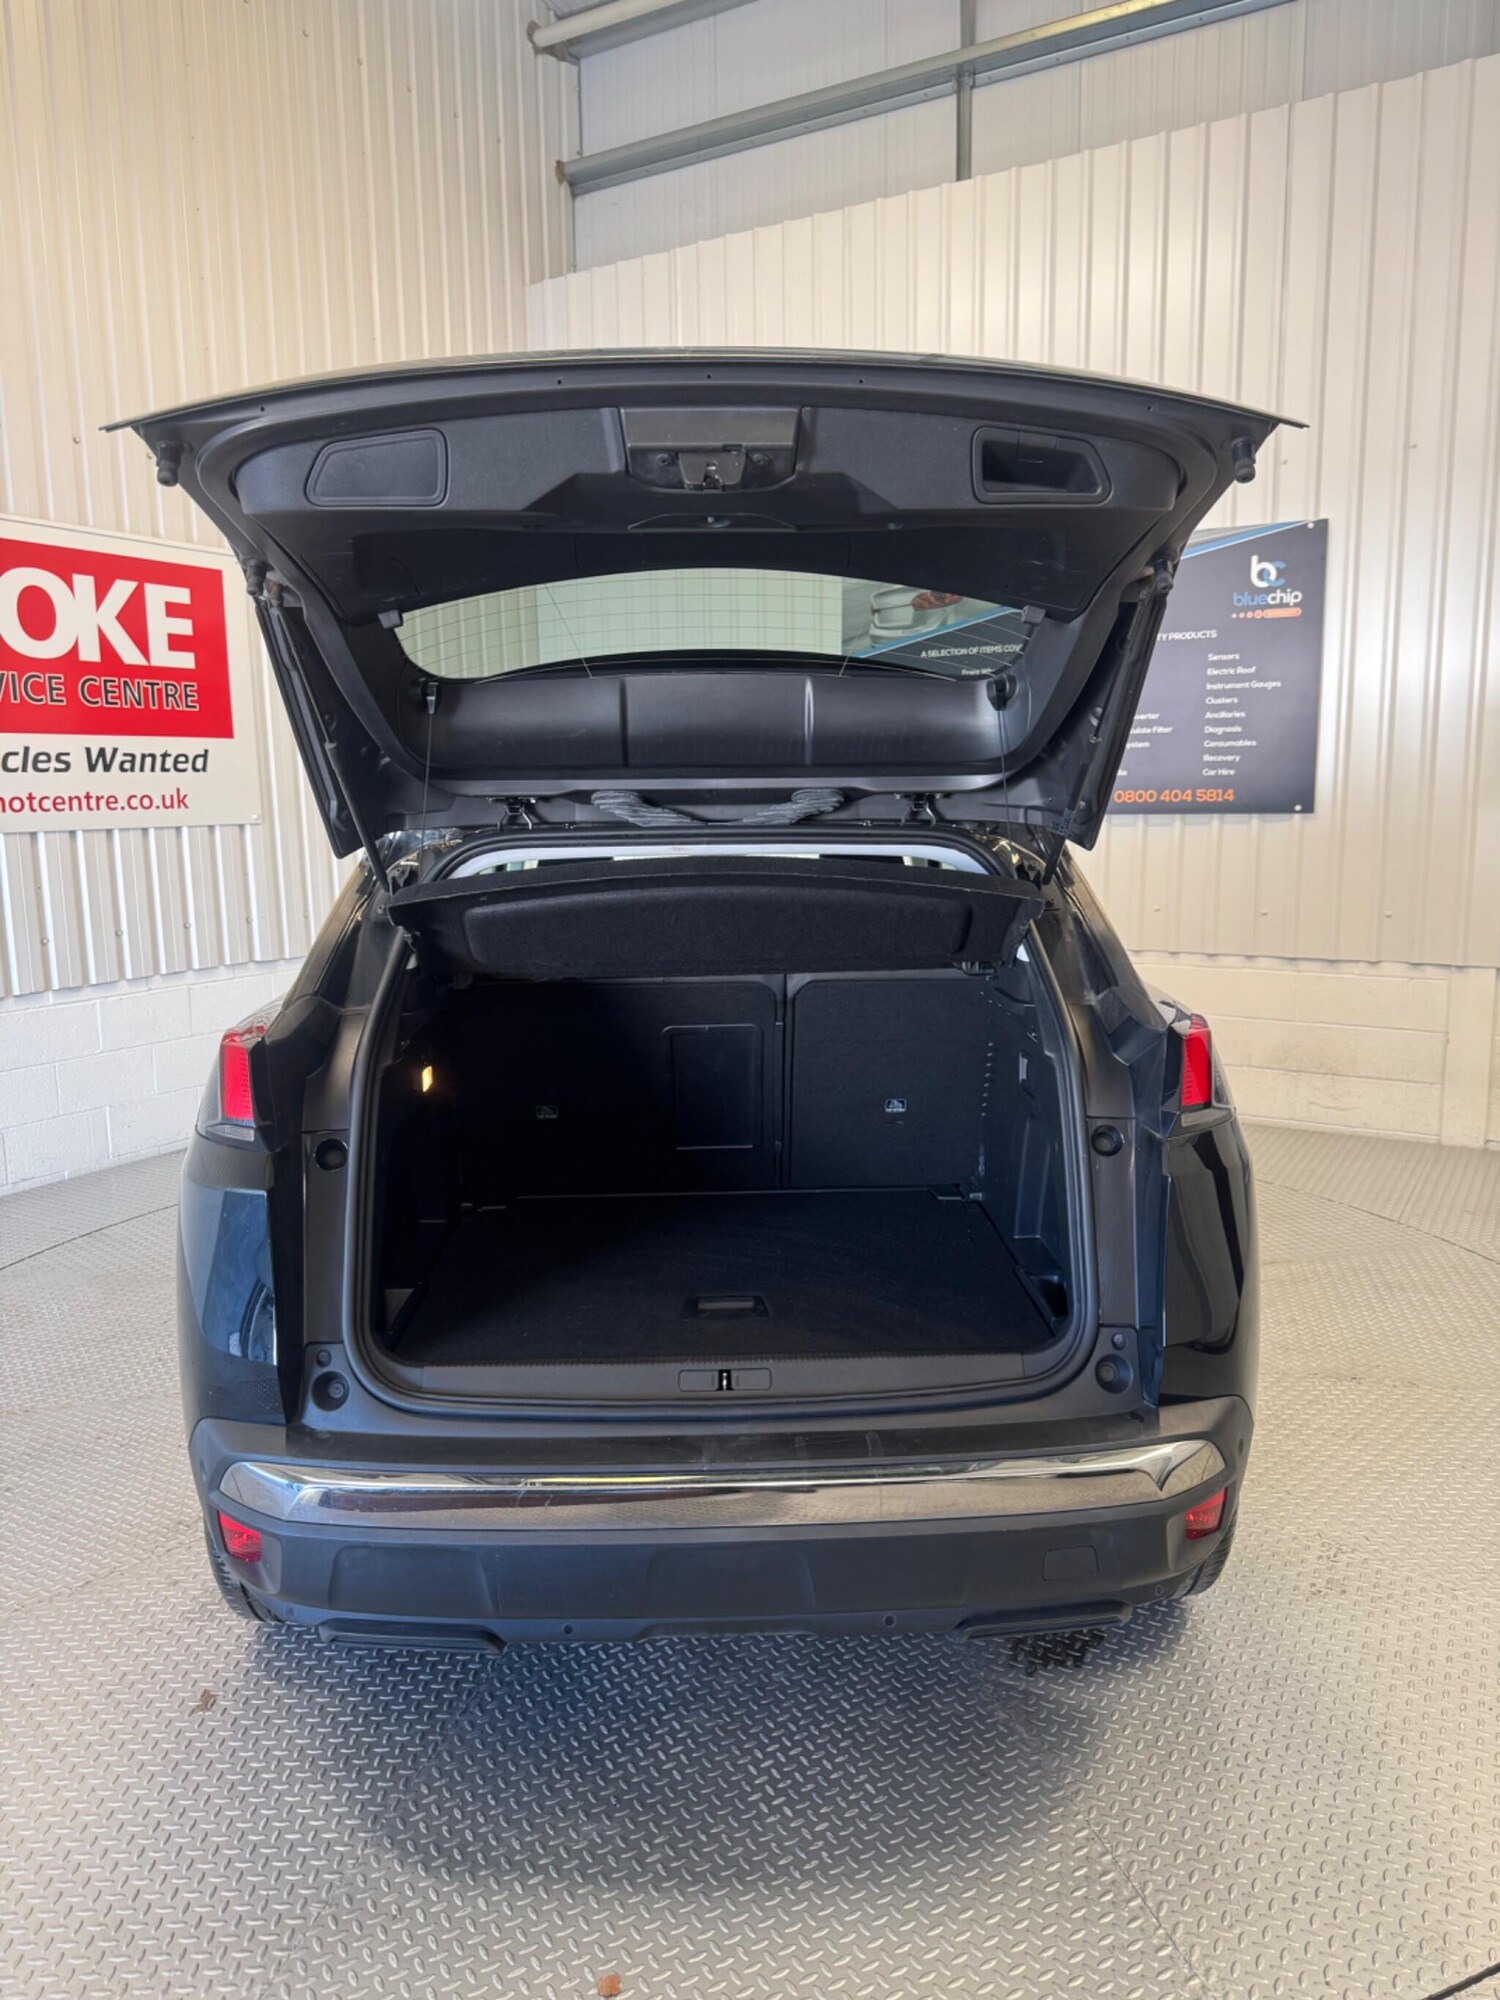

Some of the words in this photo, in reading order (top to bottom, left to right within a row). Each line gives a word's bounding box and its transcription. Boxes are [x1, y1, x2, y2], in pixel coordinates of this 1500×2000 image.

[1233, 588, 1302, 607] bluechip
[0, 566, 196, 669] OKE
[1169, 629, 1217, 641] PRODUCTS
[928, 647, 967, 657] SELECTION
[1207, 653, 1240, 661] Sensors
[1206, 667, 1235, 676] Electric
[1236, 665, 1257, 674] Roof
[1206, 682, 1249, 691] Instrument
[1250, 680, 1282, 690] Gauges
[79, 676, 199, 711] CENTRE
[1204, 697, 1239, 705] Clusters
[1204, 711, 1247, 719] Ancillaries
[1203, 725, 1242, 735] Diagnosis
[1203, 739, 1257, 748] Consumables
[1, 745, 71, 773] cles
[85, 747, 209, 773] Wanted
[1202, 754, 1240, 763] Recovery
[1202, 768, 1217, 776] Car
[1218, 767, 1236, 775] Hire
[1113, 789, 1157, 803] 0800
[1160, 788, 1192, 802] 404
[1195, 788, 1235, 802] 5814
